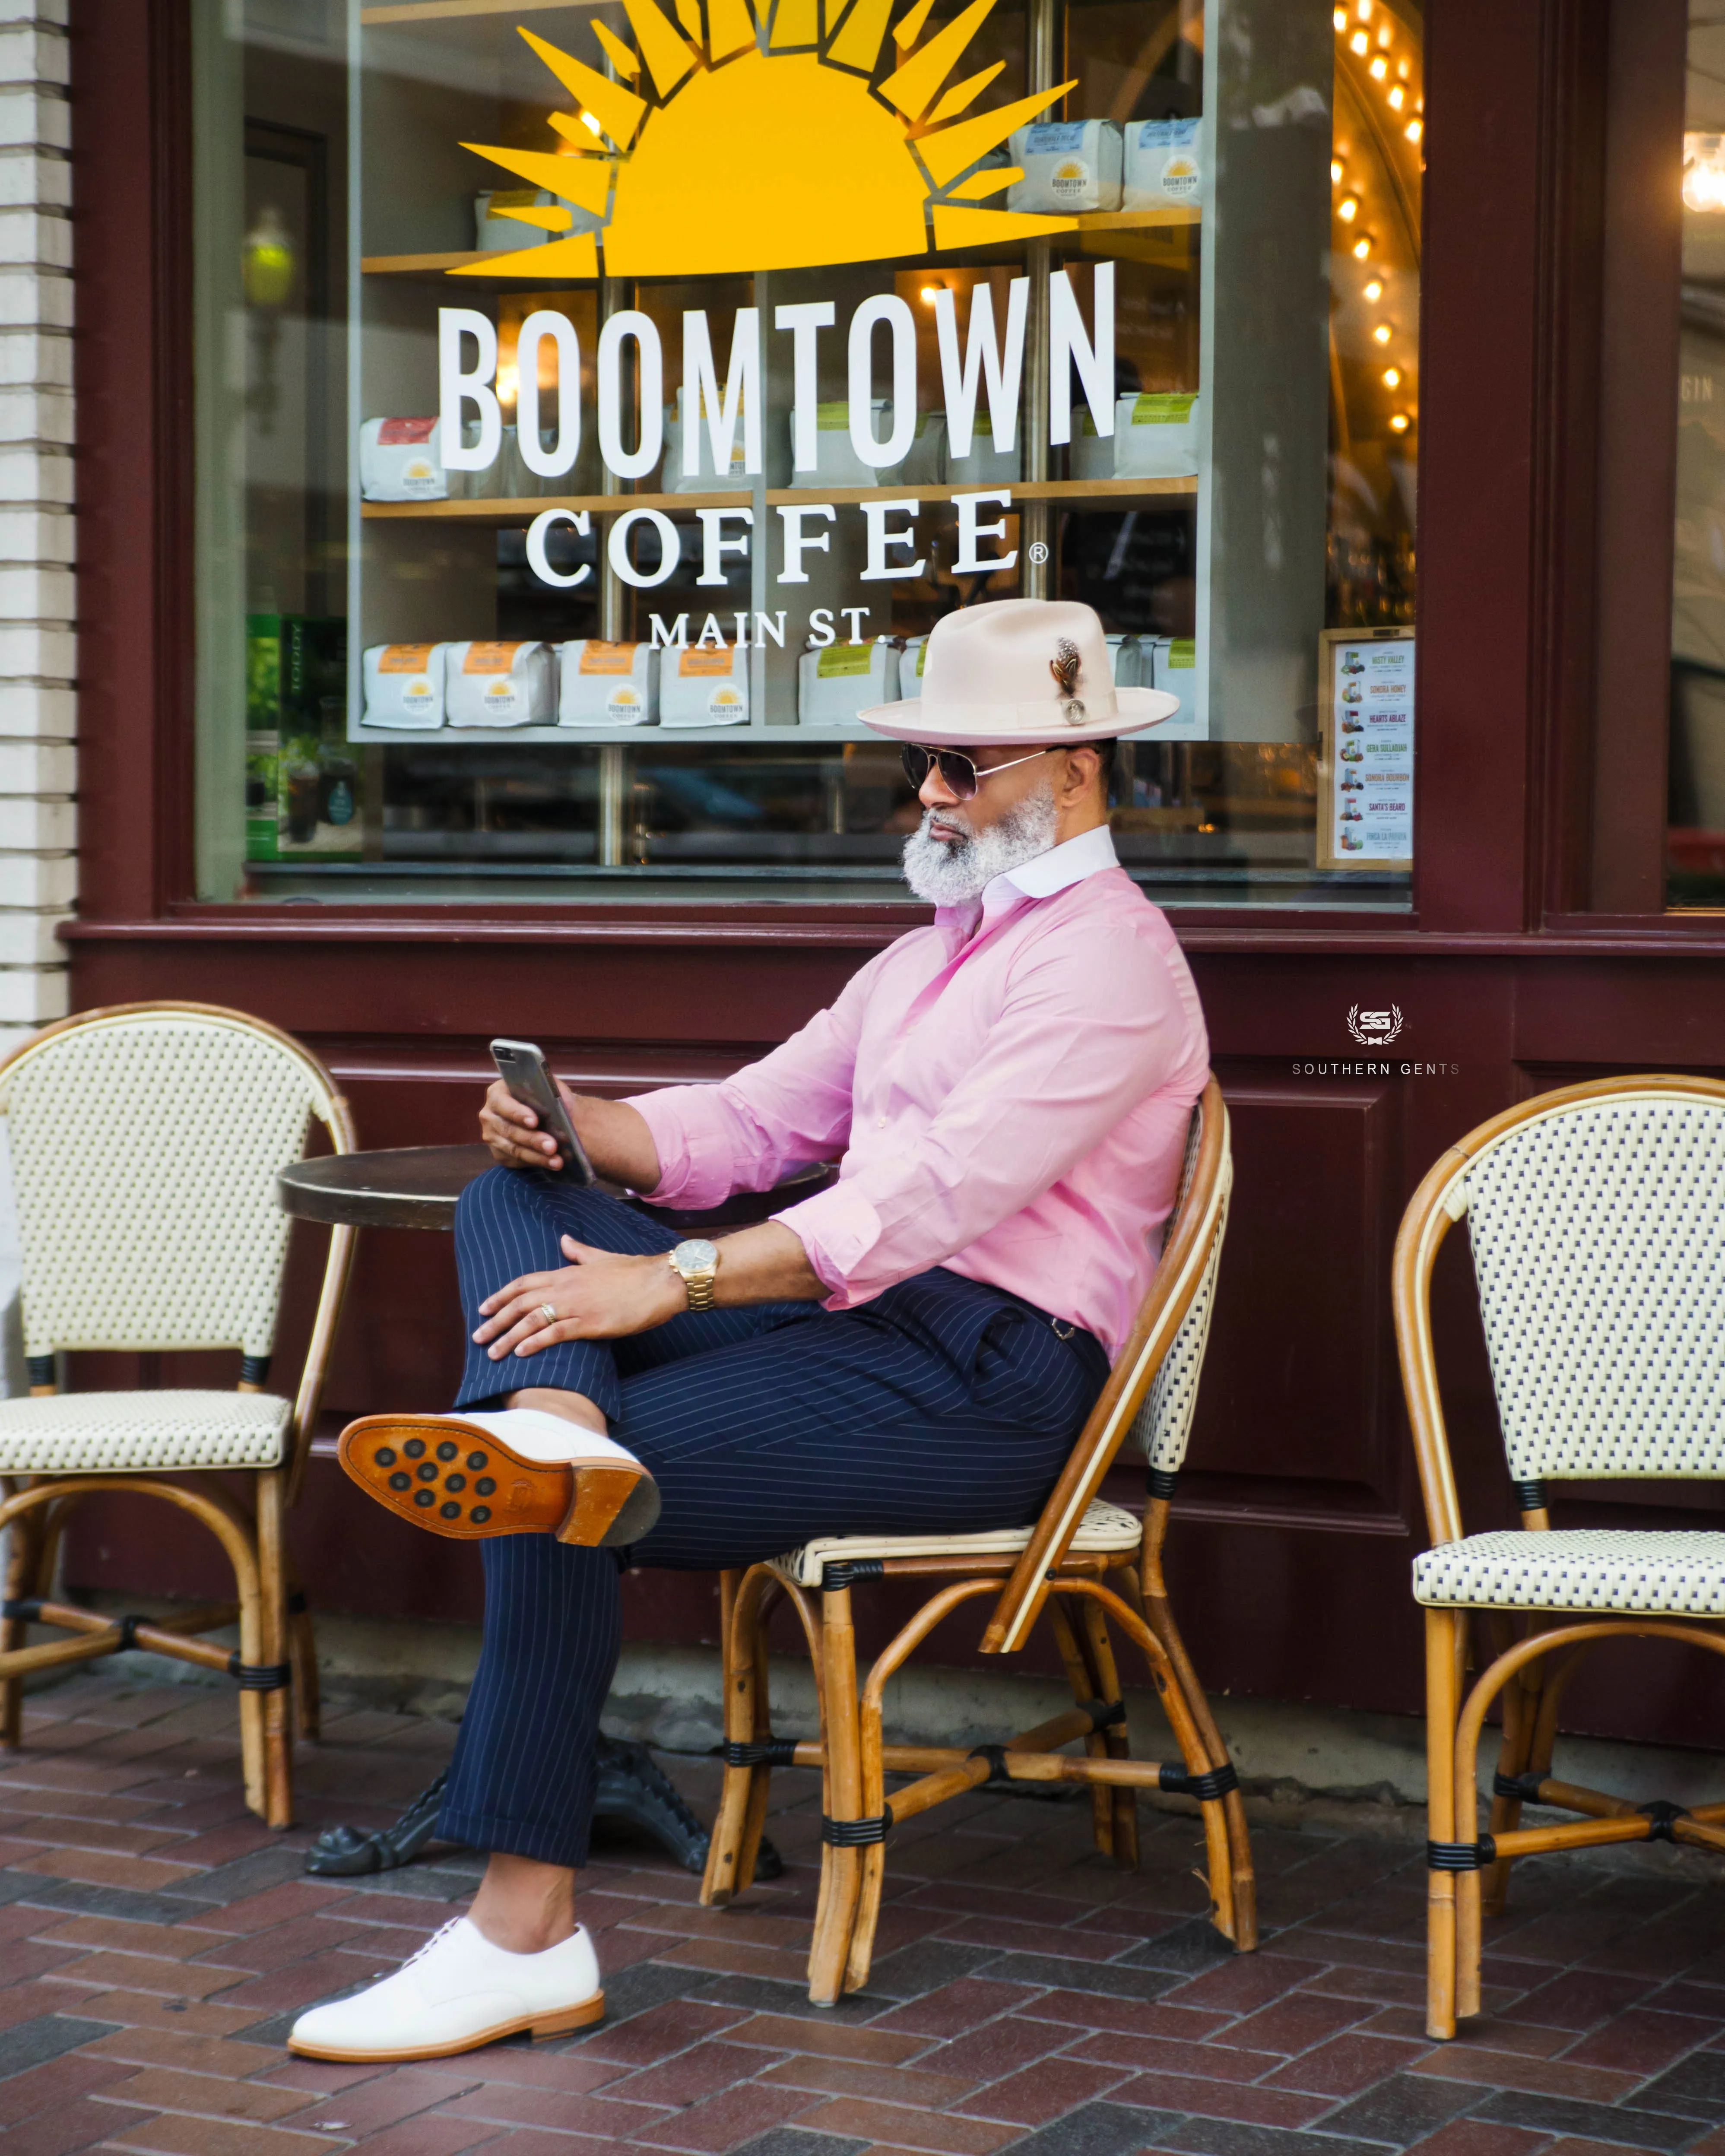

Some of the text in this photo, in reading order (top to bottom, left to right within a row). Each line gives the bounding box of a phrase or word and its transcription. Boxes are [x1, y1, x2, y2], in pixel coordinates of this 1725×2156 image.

[440, 262, 1114, 478] BOOMTOWN
[649, 608, 887, 650] MAIN ST.
[1369, 714, 1407, 723] HEARTS ABLAZE
[1369, 803, 1405, 811] SANTA'S BEARD
